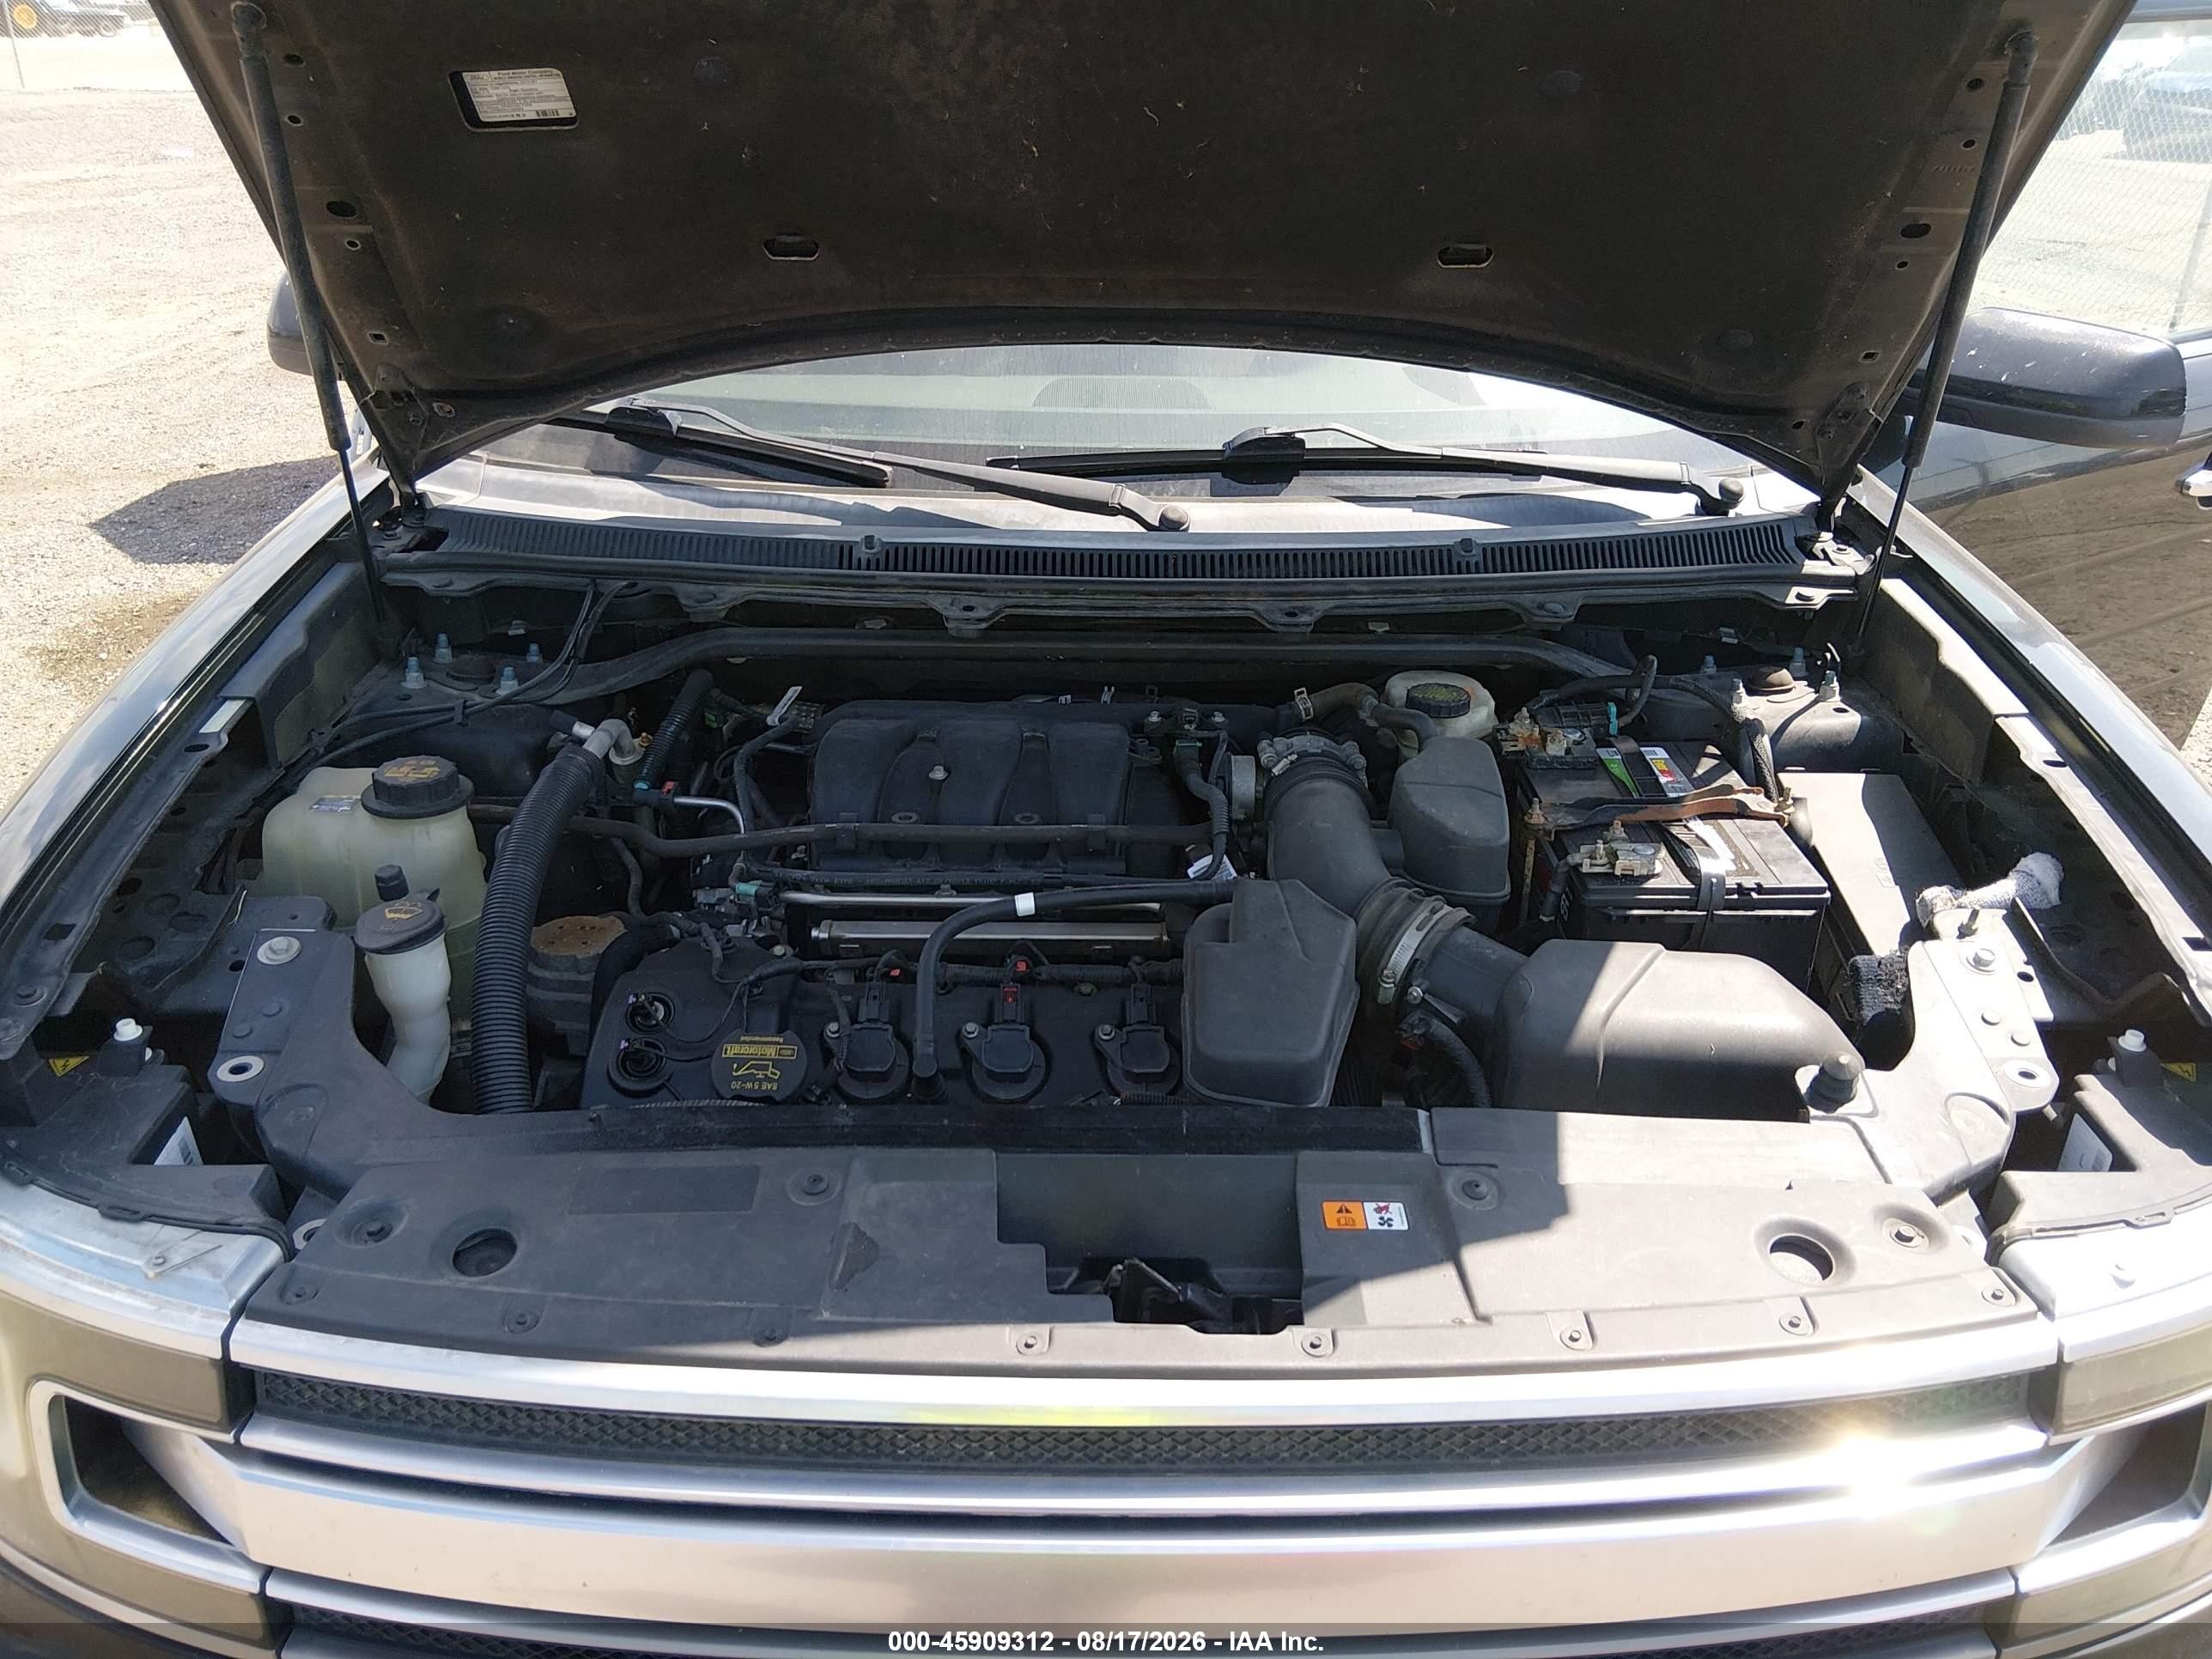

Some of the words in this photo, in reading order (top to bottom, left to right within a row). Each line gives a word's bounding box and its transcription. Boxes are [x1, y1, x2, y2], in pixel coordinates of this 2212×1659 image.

[727, 1045, 776, 1057] Motorcraft
[731, 1080, 758, 1091] 5W-20
[761, 1082, 778, 1091] SAE
